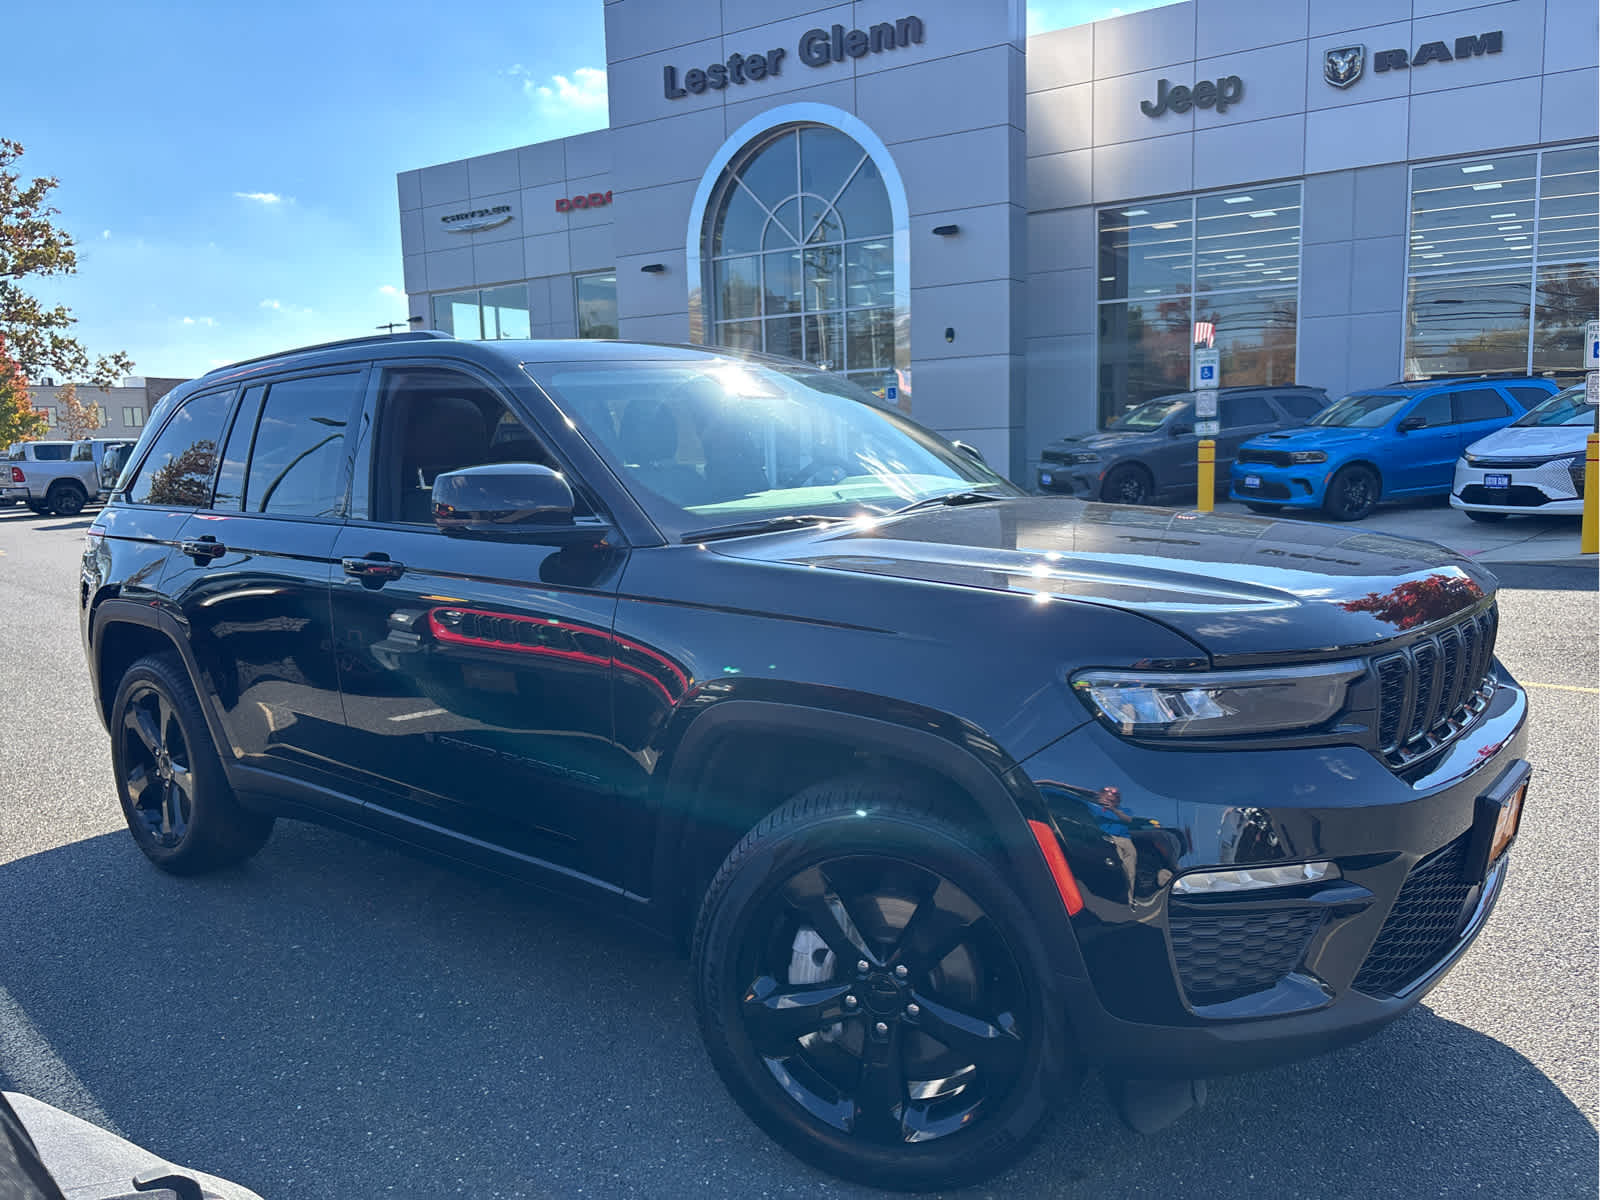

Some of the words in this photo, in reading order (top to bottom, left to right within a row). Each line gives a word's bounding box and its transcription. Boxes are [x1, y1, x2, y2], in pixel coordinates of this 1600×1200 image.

[663, 48, 786, 100] Lester
[799, 15, 924, 68] Glenn
[1374, 31, 1503, 73] RAM
[1140, 75, 1243, 118] Jeep
